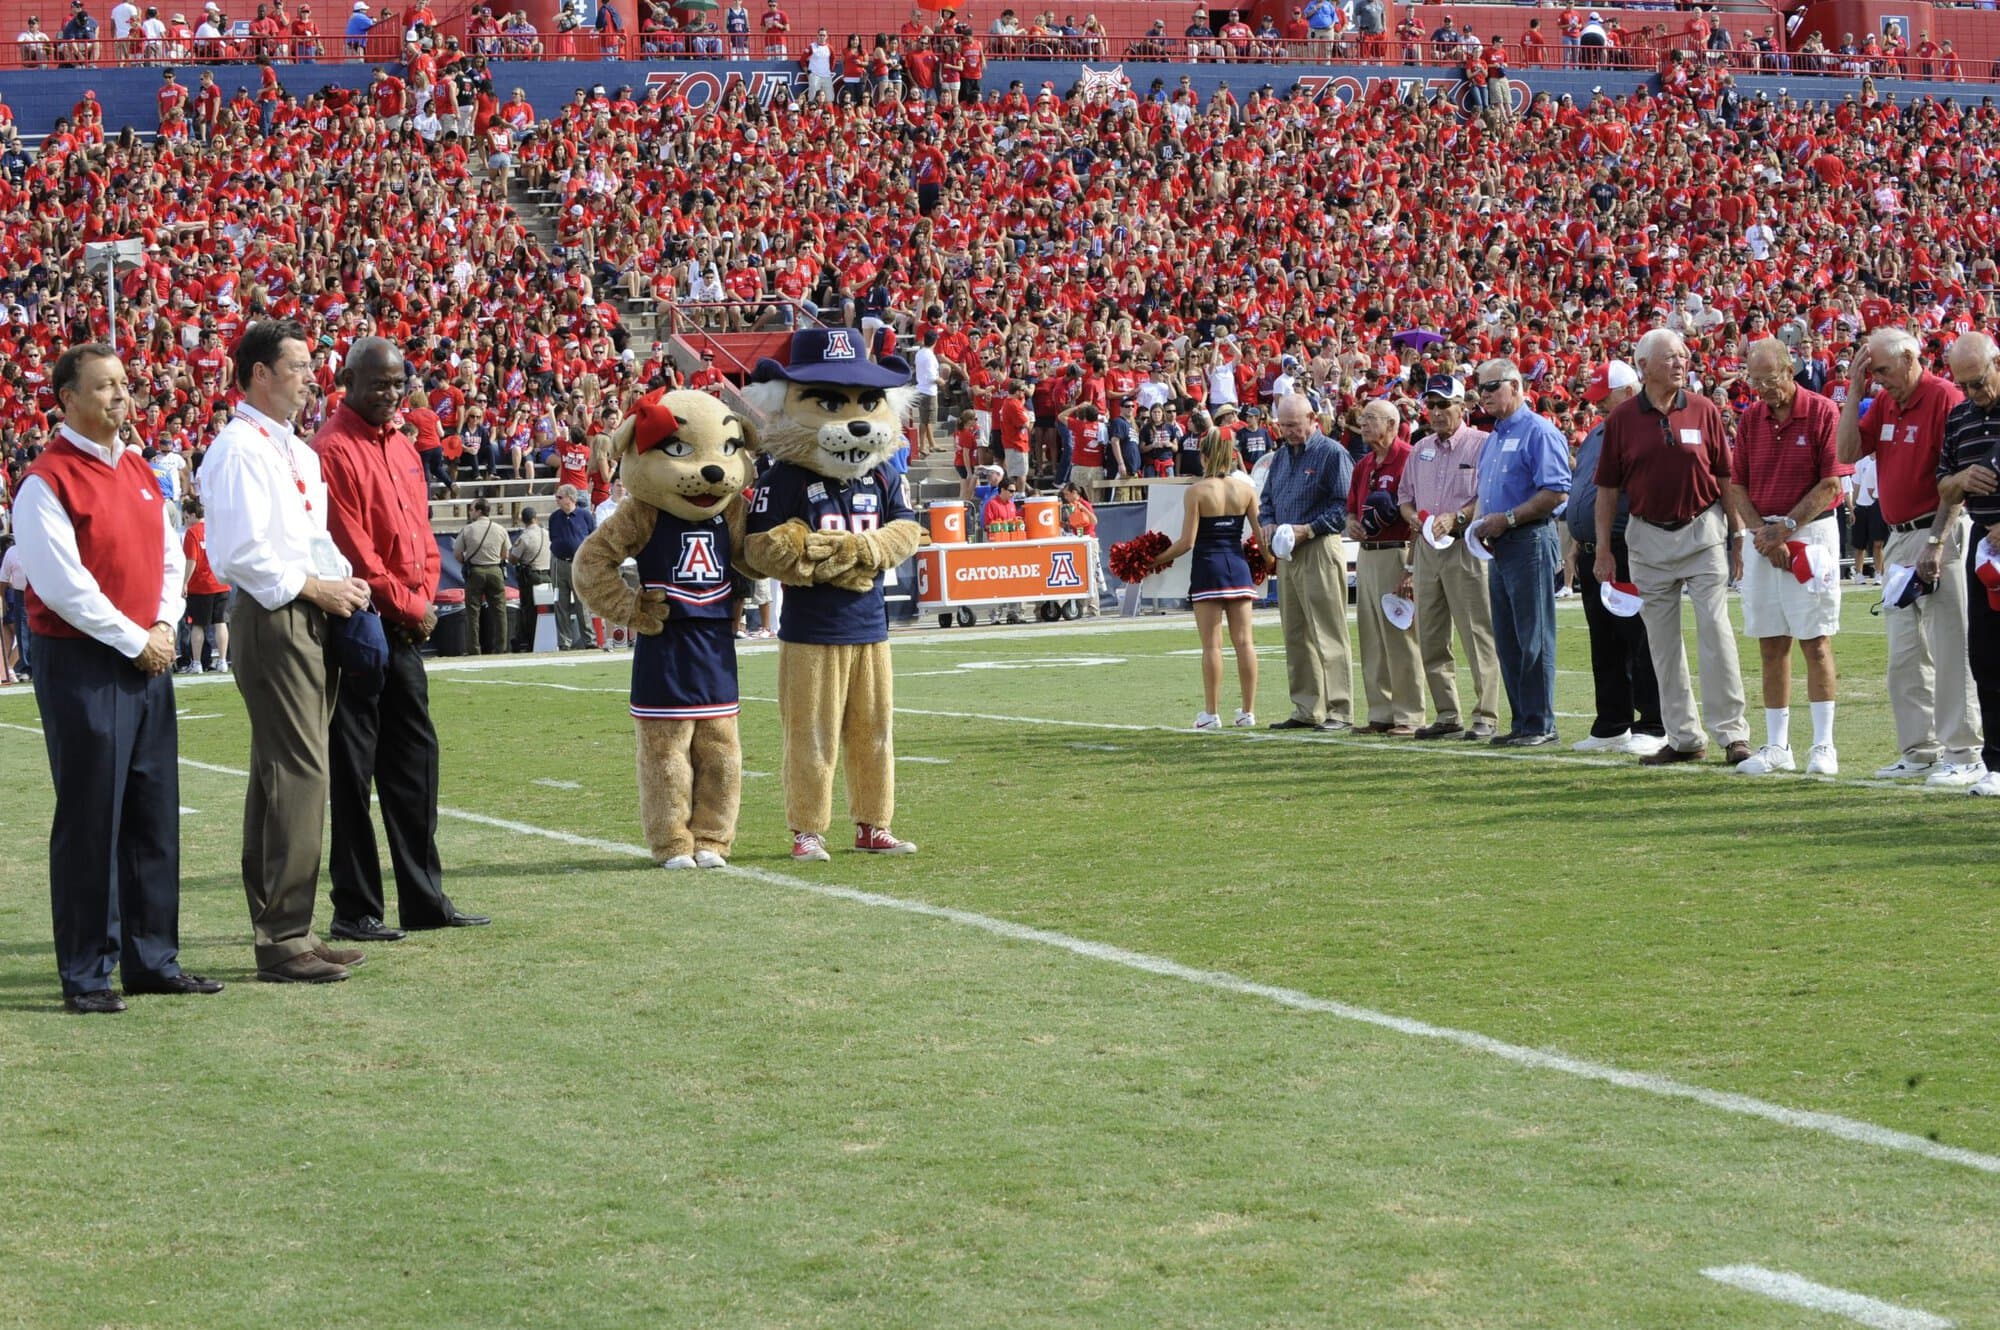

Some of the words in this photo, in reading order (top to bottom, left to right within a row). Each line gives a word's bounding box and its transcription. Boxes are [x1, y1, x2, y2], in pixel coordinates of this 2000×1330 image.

[823, 331, 856, 360] A
[672, 531, 724, 583] A
[955, 563, 1041, 582] GATORADE
[1047, 551, 1082, 589] A
